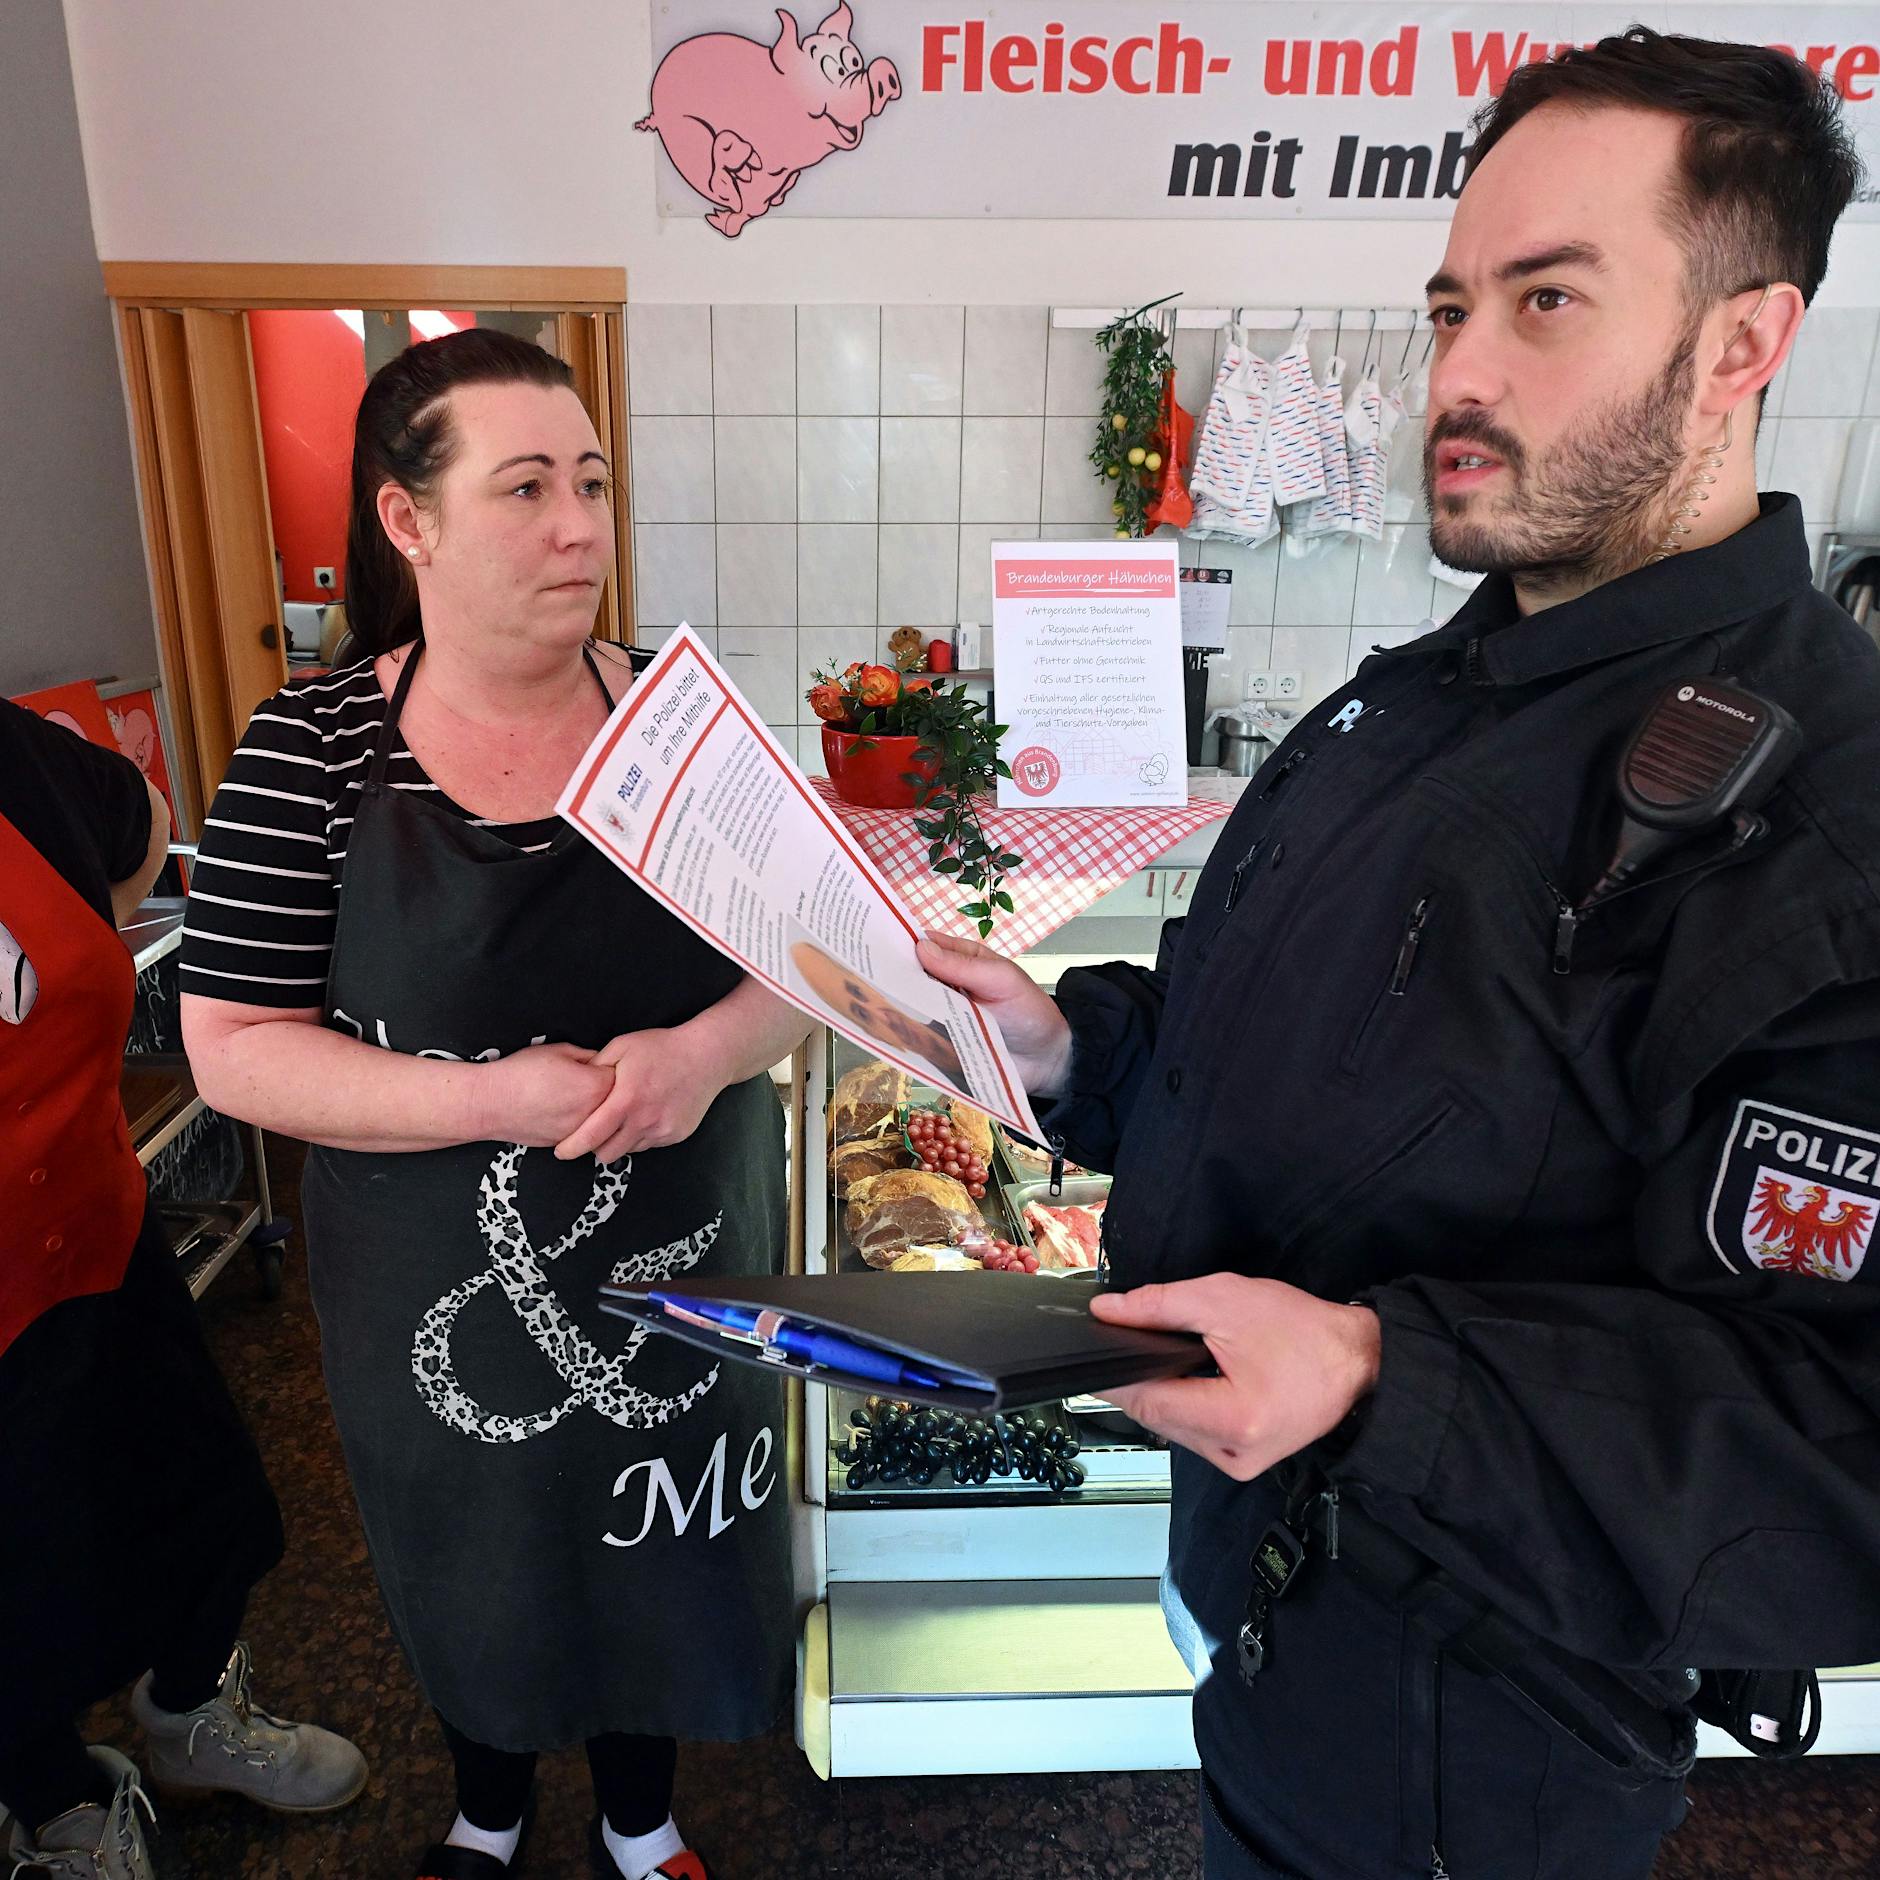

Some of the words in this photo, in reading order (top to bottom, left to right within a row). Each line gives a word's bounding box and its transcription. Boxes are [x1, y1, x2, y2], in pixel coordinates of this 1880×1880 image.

[922, 21, 1231, 94] Fleisch-
[1264, 26, 1419, 96] und
[1167, 131, 1302, 198] mit
[1328, 132, 1472, 199] Imb
[1006, 571, 1104, 588] Brandenburger
[1108, 569, 1172, 585] Hähnchen
[1031, 605, 1087, 618] Artgerechte
[1090, 605, 1151, 617] Bodenhaltung
[1025, 638, 1033, 646] in
[1036, 636, 1152, 647] Landwirtschaftsbetrieben
[1047, 624, 1089, 636] Regionale
[1092, 624, 1134, 635] Aufzucht
[1040, 656, 1070, 665] Futter
[1073, 656, 1094, 665] ohne
[1096, 656, 1146, 666] Gentechnik
[1039, 674, 1053, 684] QS
[1056, 674, 1071, 684] und
[1074, 674, 1094, 684] IFS
[1096, 674, 1147, 684] zertifiziert
[641, 723, 660, 747] Die
[653, 687, 683, 729] Polizei
[676, 668, 700, 697] bittet
[1029, 694, 1077, 706] Einhaltung
[1080, 694, 1099, 703] aller
[1101, 694, 1156, 706] gesetzlichen
[1696, 695, 1756, 723] MOTOROLA
[660, 744, 675, 766] um
[668, 724, 688, 750] Ihre
[681, 690, 711, 729] Mithilfe
[1035, 718, 1051, 728] und
[617, 763, 643, 802] POLIZEI
[1743, 1118, 1880, 1188] POLIZ
[602, 1427, 777, 1547] Me
